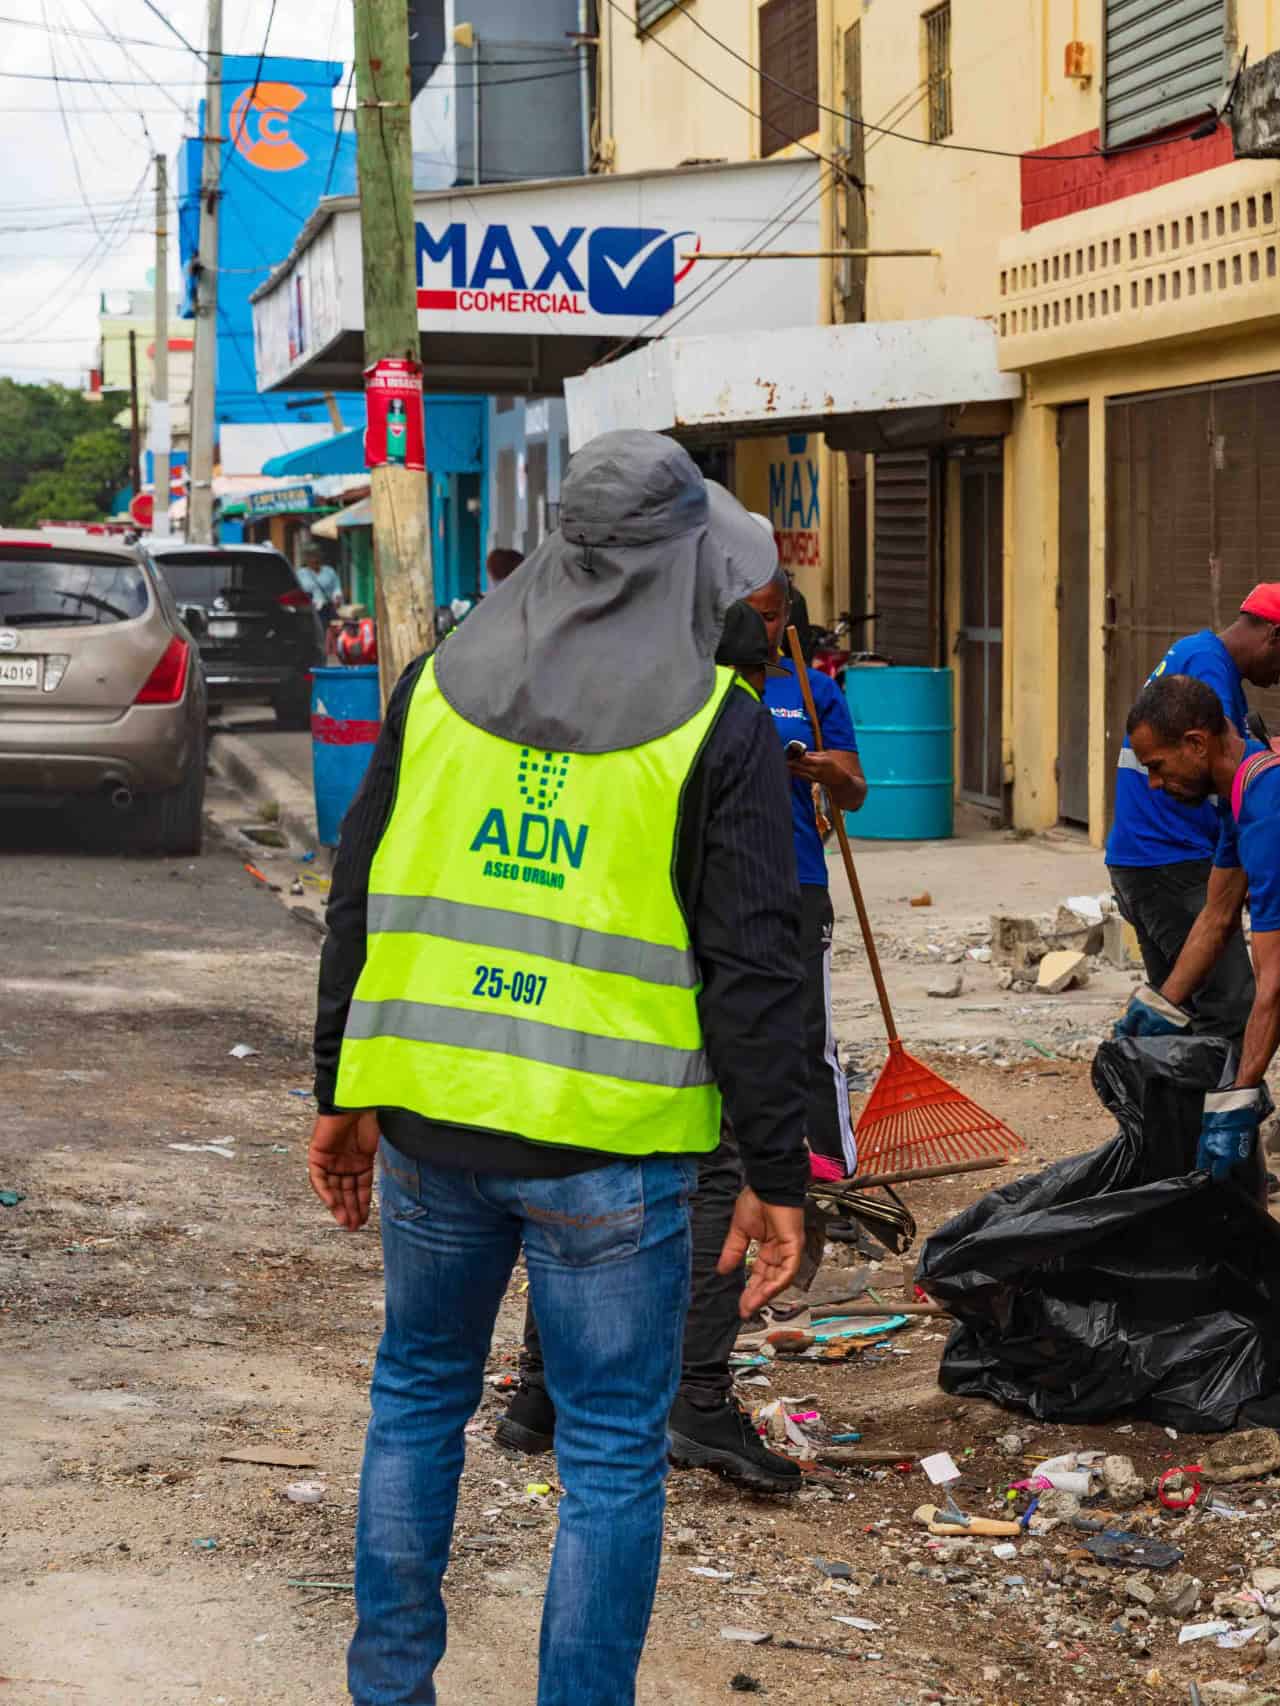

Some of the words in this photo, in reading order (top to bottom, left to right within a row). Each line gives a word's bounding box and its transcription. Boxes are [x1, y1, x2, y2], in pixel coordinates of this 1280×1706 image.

[414, 221, 587, 292] MAX
[459, 291, 585, 314] COMERCIAL
[769, 460, 820, 529] MAX
[469, 808, 589, 869] ADN
[483, 860, 519, 881] ASEO
[522, 866, 565, 890] URBANO
[472, 966, 547, 1005] 25-097
